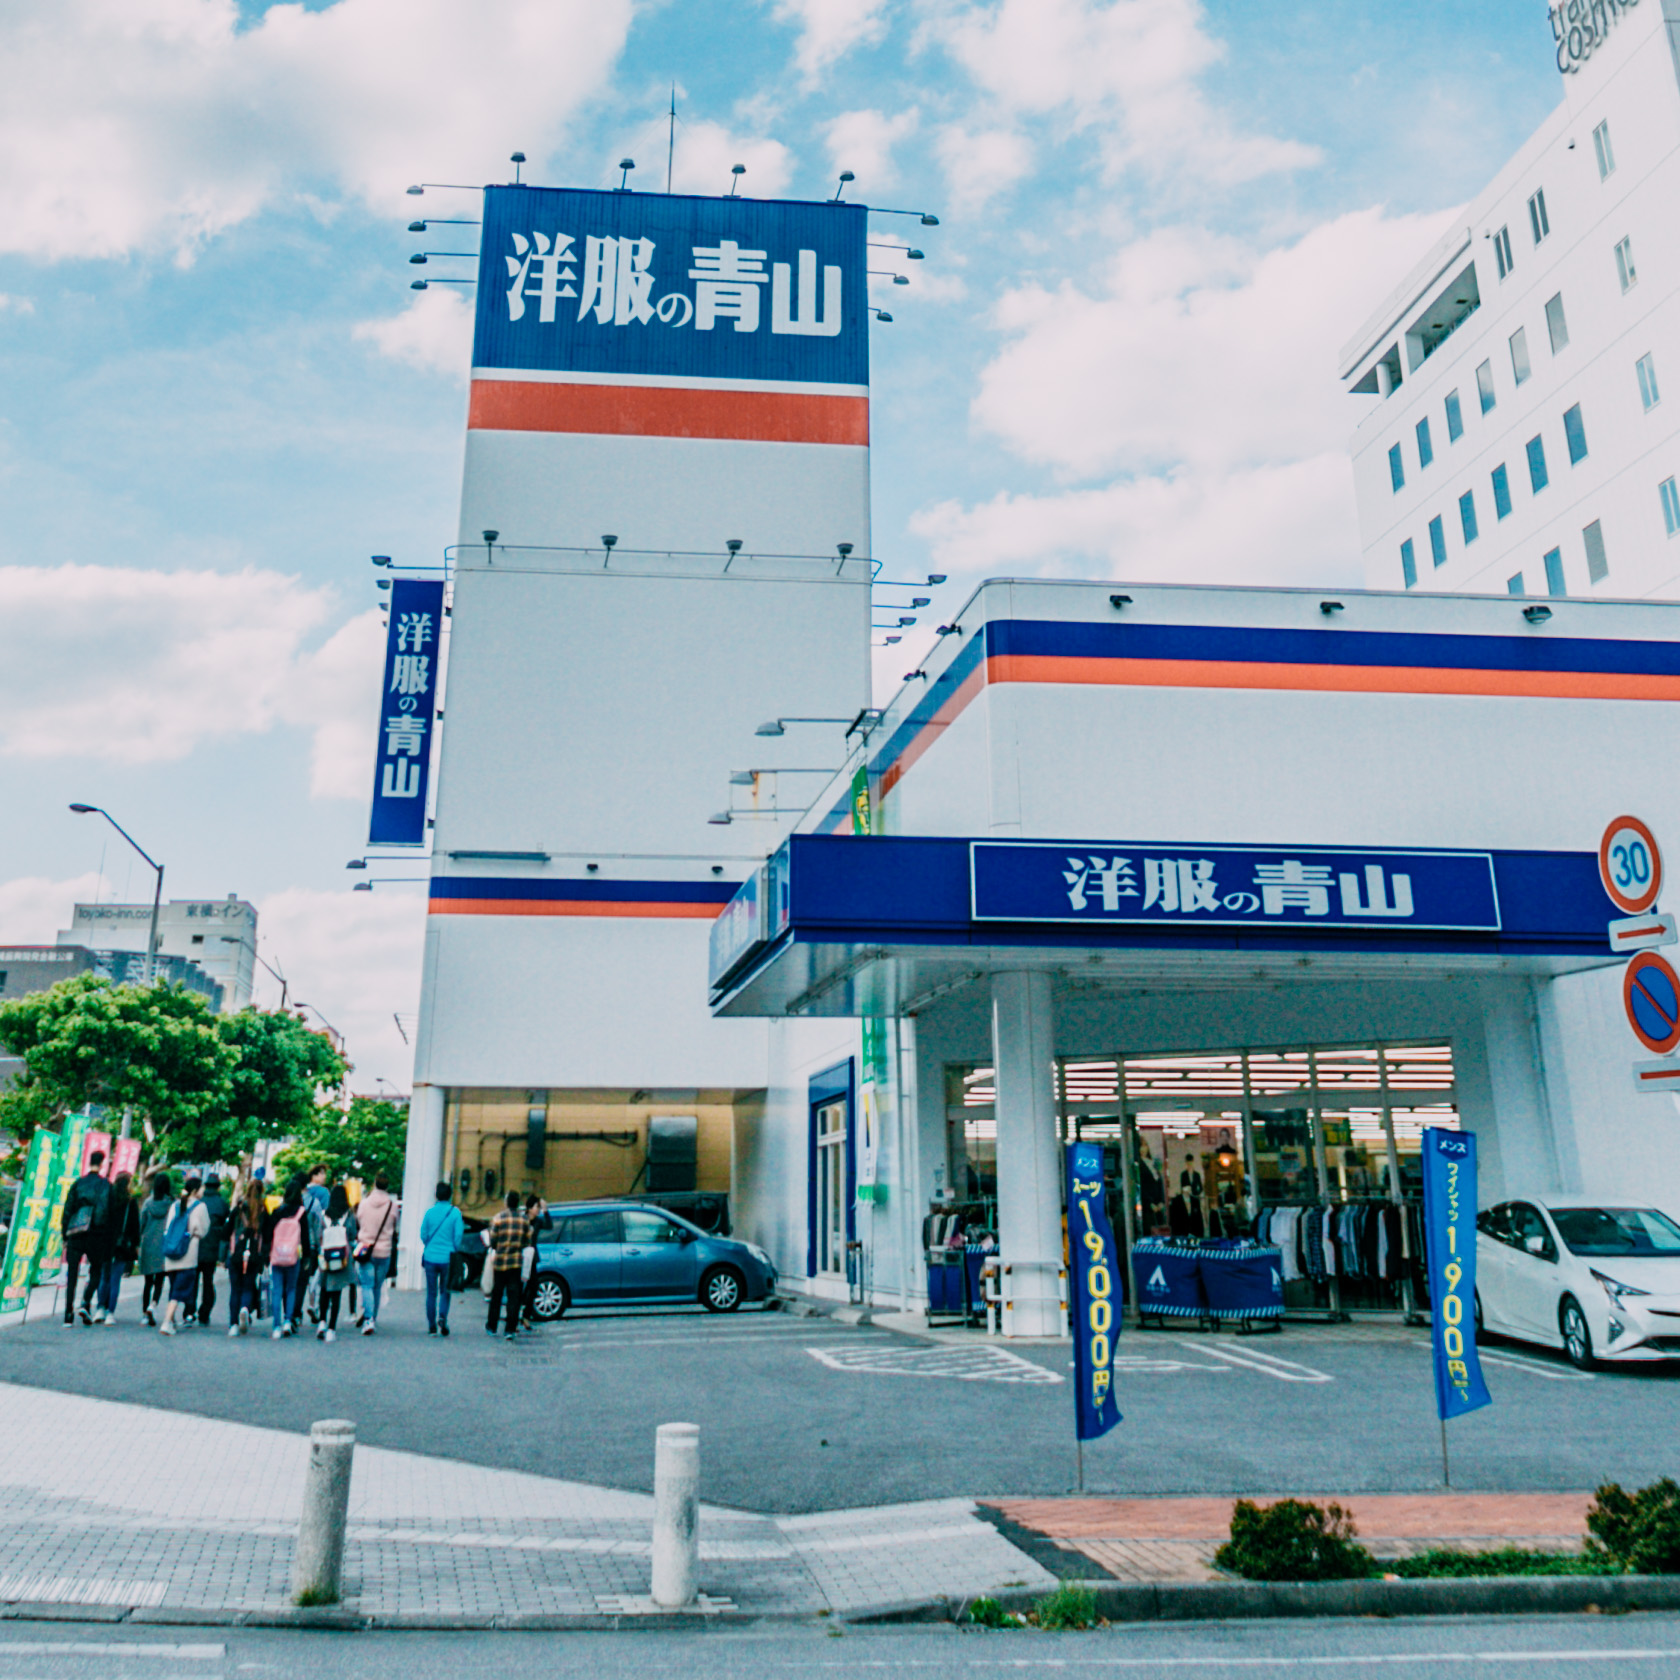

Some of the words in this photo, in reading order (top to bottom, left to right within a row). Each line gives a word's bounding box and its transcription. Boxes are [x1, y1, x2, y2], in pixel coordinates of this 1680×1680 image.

[505, 231, 842, 337] 洋服の青山
[381, 611, 433, 799] 洋服の青山
[1062, 855, 1415, 918] 洋服の青山
[1612, 841, 1650, 888] 30
[1076, 1157, 1099, 1170] メンズ
[1439, 1139, 1467, 1154] メンズ
[1072, 1178, 1102, 1197] スーツ
[12, 1198, 50, 1287] 下取り
